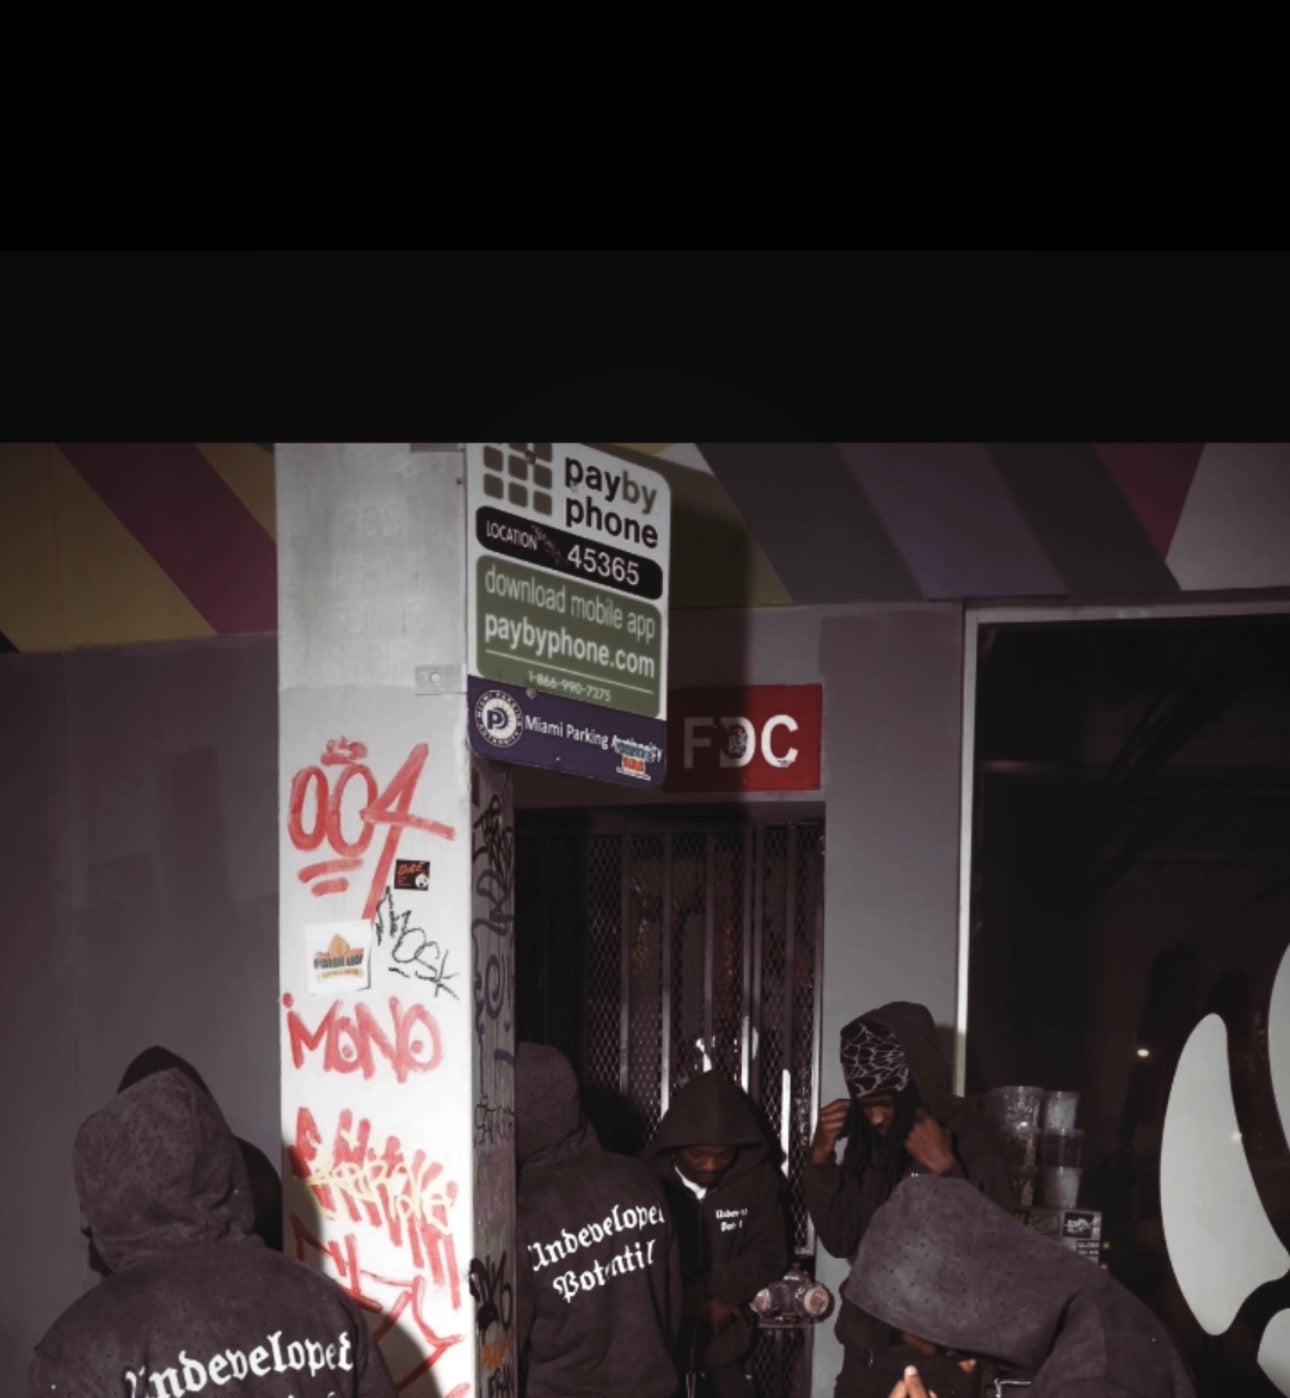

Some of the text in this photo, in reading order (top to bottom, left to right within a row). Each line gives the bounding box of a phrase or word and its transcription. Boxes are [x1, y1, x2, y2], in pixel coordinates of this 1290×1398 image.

[565, 456, 657, 515] payby
[565, 496, 658, 549] phone
[485, 519, 538, 550] LOCATION
[566, 543, 640, 586] 45365
[484, 563, 656, 646] download mobile app
[484, 612, 656, 680] paybyphone.com
[525, 714, 564, 738] Miami
[566, 723, 608, 752] Parking
[683, 713, 800, 770] FDC
